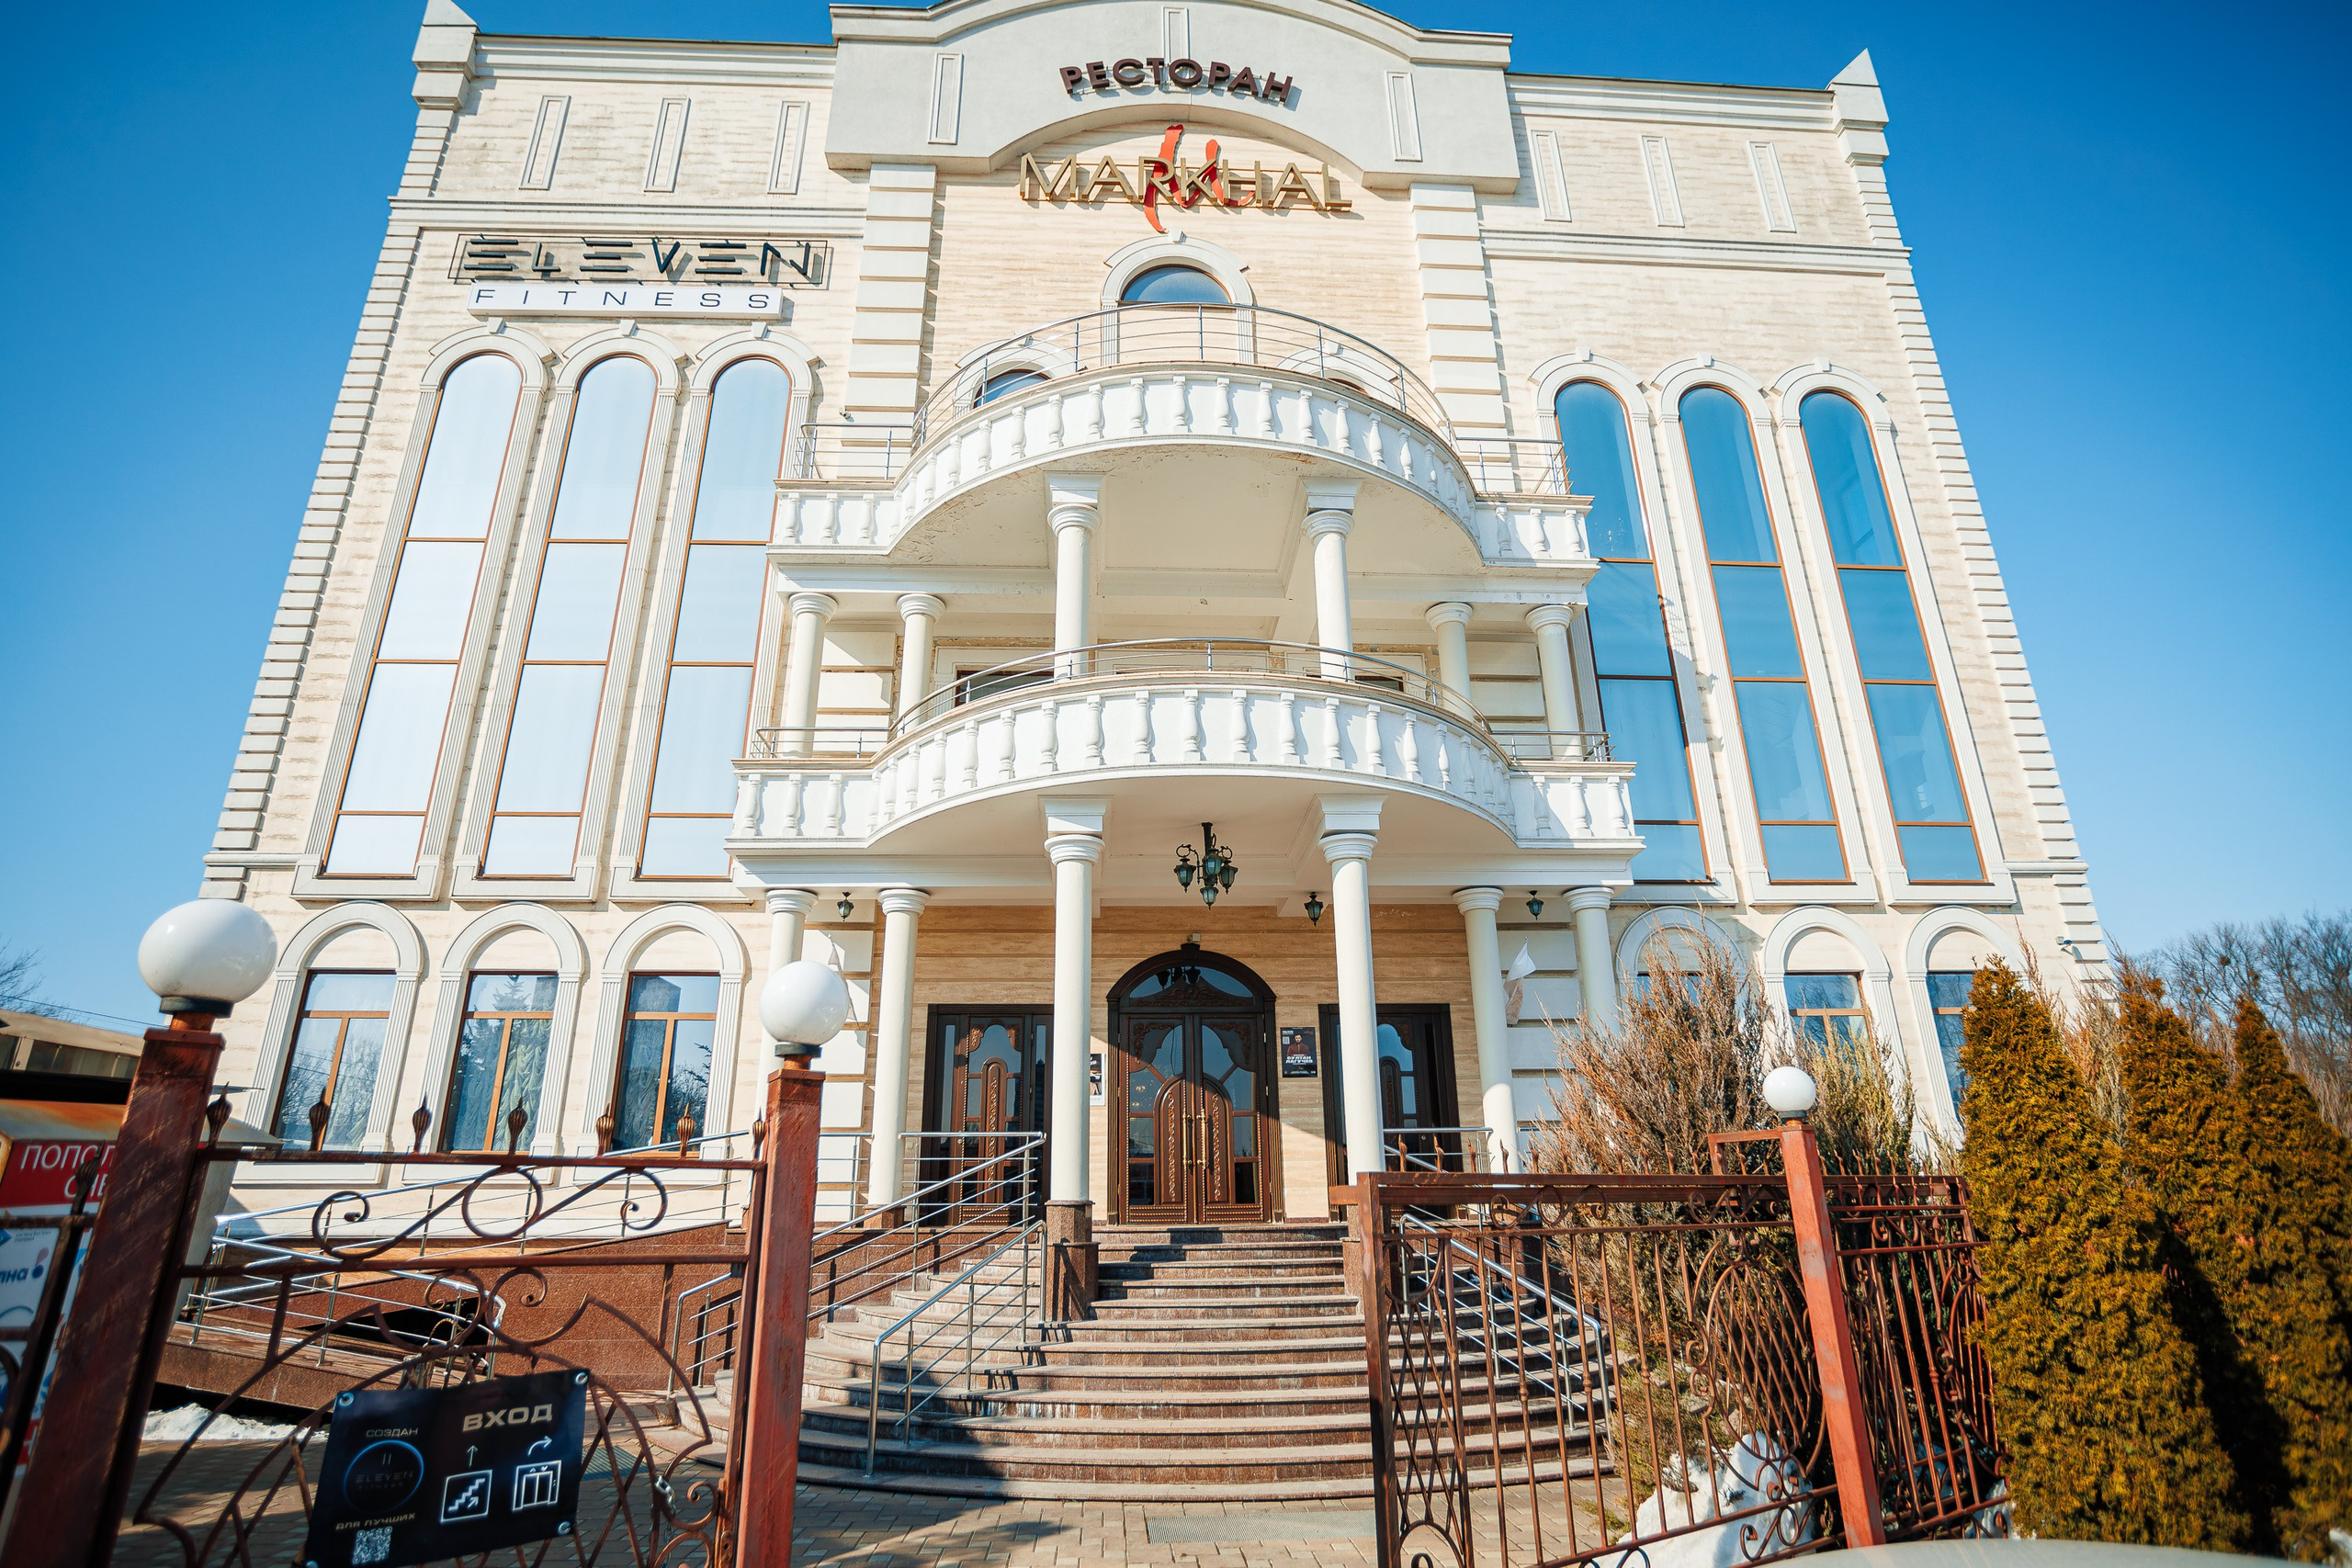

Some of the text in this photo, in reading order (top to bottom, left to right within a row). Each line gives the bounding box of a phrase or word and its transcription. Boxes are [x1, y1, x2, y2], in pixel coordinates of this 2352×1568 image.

[1059, 57, 1294, 103] РЕСТОРАН
[1019, 152, 1352, 209] MARKHAL
[463, 238, 811, 276] ELEVEN
[474, 289, 770, 310] FITNESS
[462, 1404, 553, 1433] ВХОД
[366, 1427, 419, 1438] СОЗДАН
[356, 1470, 413, 1483] ELEVEN
[335, 1512, 416, 1530] ДЛЯ ЛУЧШИХ
